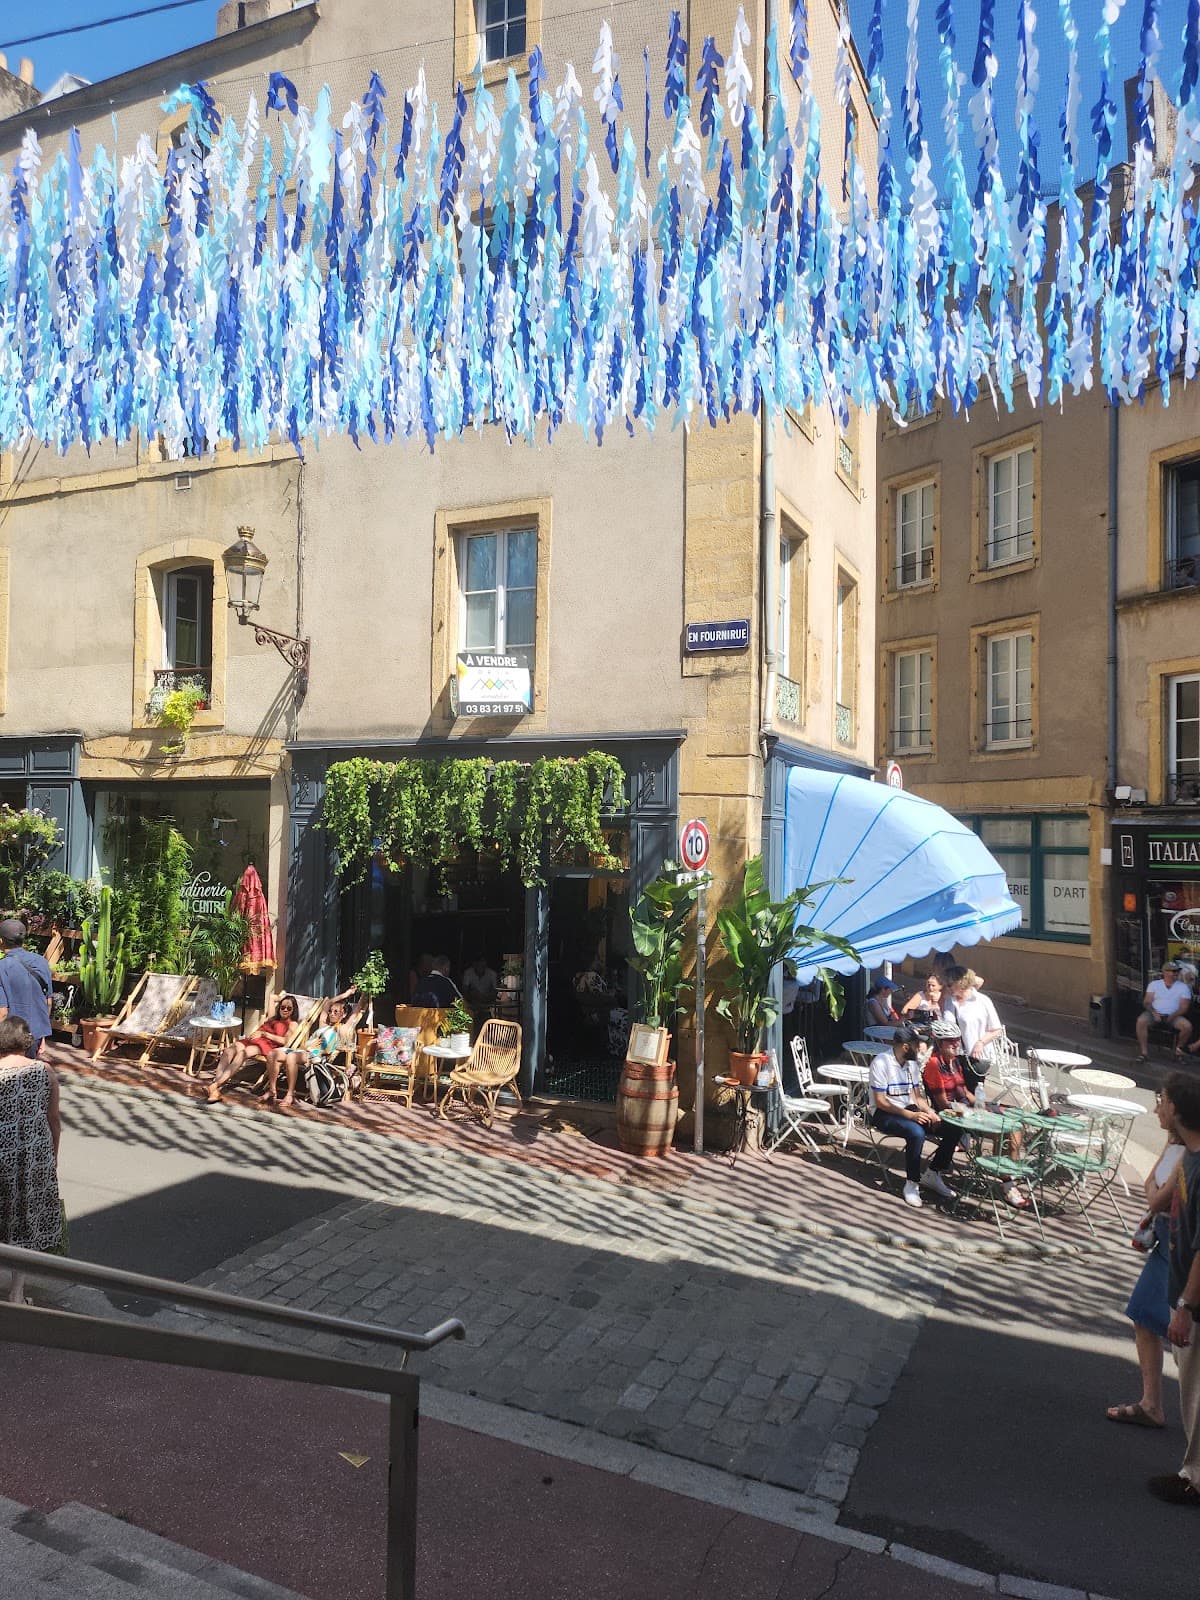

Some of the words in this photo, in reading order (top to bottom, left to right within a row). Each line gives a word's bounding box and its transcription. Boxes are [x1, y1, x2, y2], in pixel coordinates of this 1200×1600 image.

[688, 632, 698, 643] EN
[700, 629, 747, 642] FOURNIRUE
[476, 655, 518, 667] VENDRE
[466, 704, 478, 713] 03
[480, 704, 491, 713] 83
[493, 704, 501, 713] 21
[503, 704, 513, 713] 97
[515, 704, 524, 713] 51
[689, 836, 703, 857] 10
[1148, 841, 1200, 862] ITALIA
[180, 871, 227, 898] rdinerie
[1008, 884, 1029, 896] ERIE
[1053, 886, 1087, 899] D'ART
